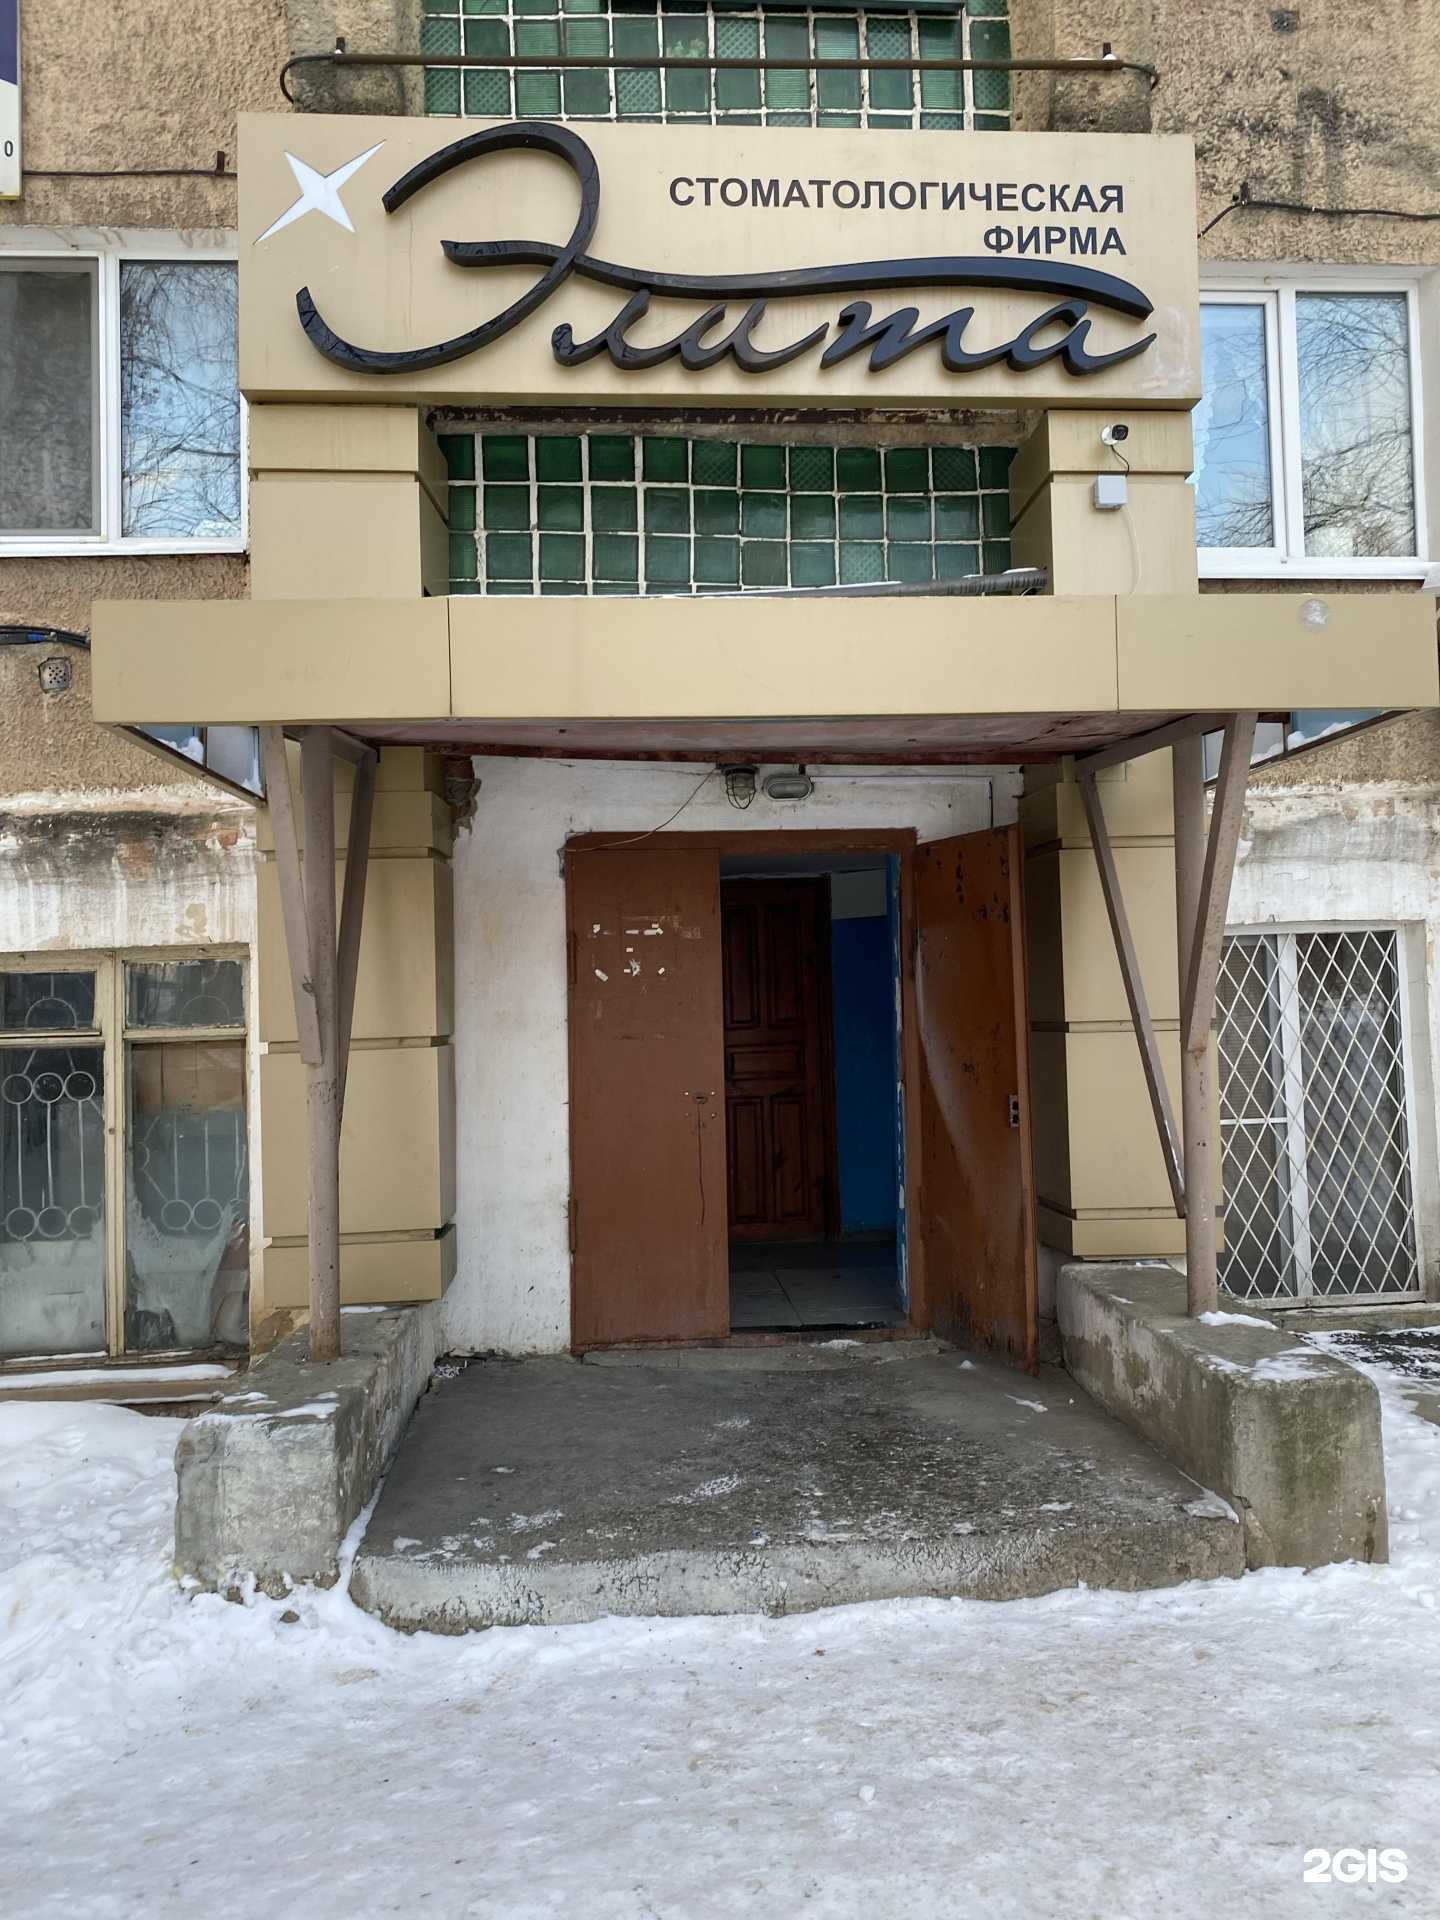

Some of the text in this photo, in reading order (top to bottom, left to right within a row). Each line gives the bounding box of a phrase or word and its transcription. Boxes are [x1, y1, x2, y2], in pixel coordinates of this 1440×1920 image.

[669, 176, 1124, 213] СТОМАТОЛОГИЧЕСКАЯ
[296, 121, 1157, 377] Элита
[983, 225, 1127, 256] ФИРМА
